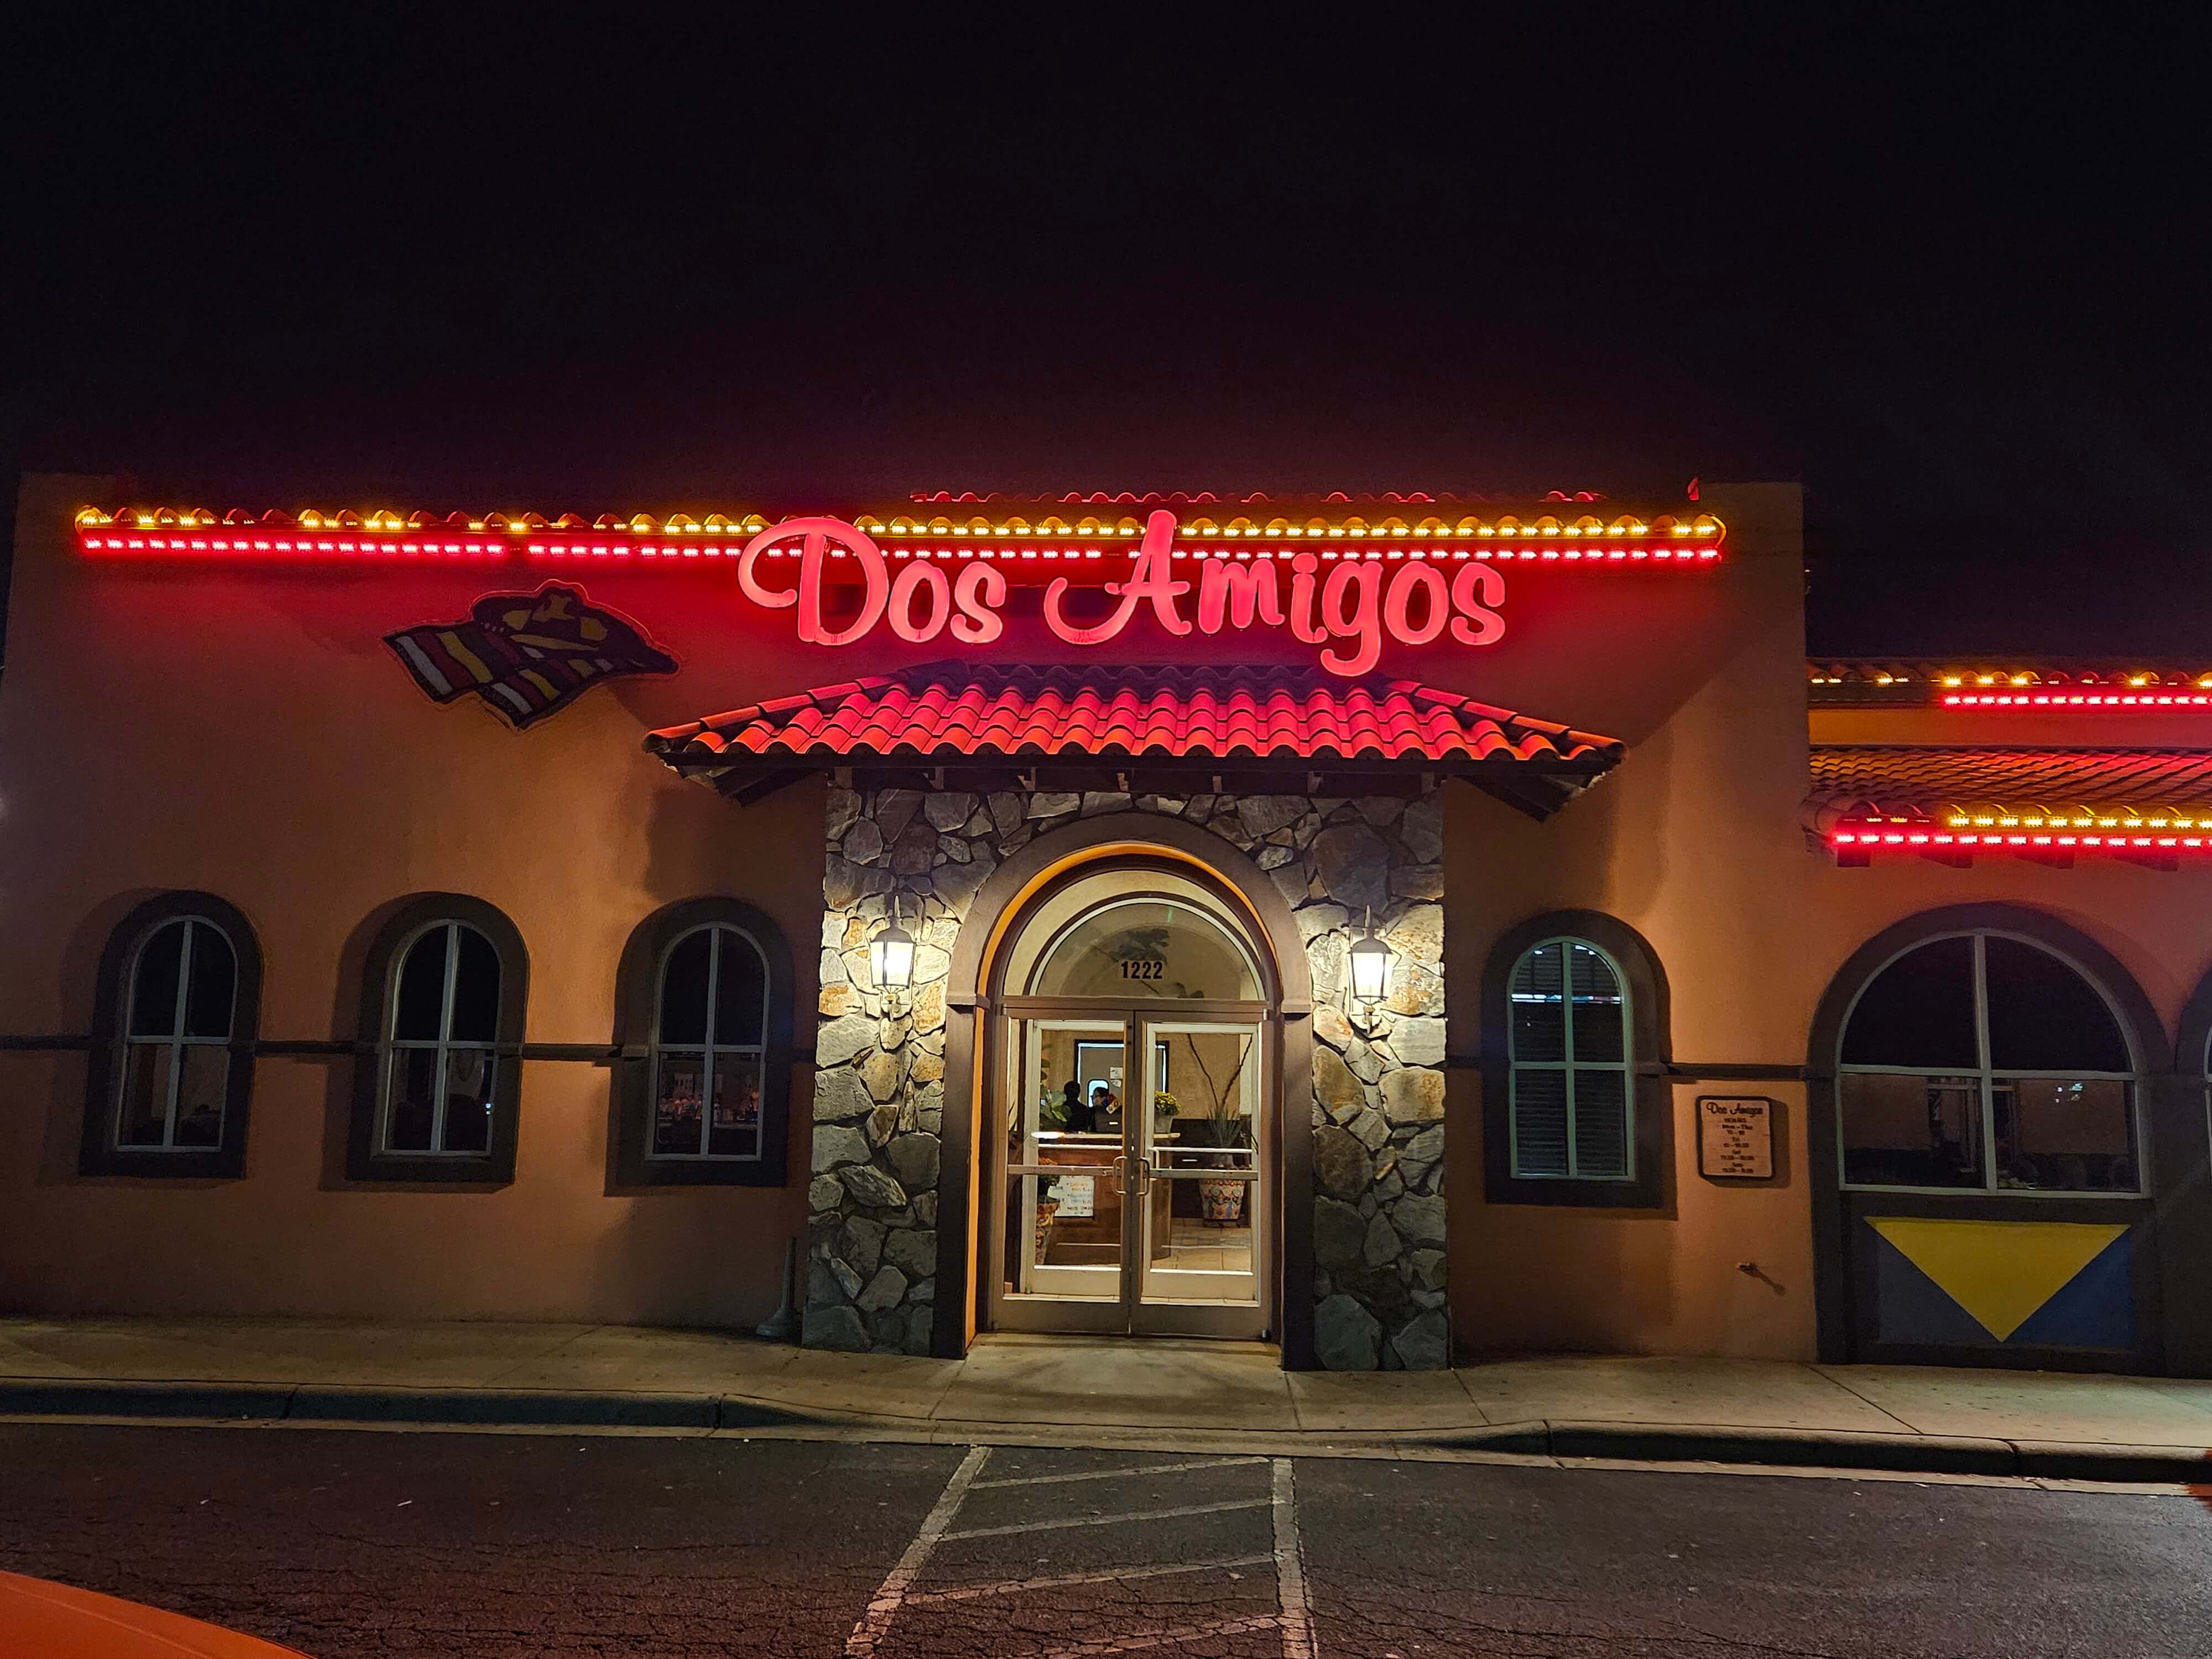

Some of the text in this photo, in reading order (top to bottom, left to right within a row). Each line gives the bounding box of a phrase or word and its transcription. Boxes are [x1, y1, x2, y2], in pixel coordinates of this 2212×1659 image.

[738, 509, 1506, 676] Dos Amigos
[1120, 961, 1162, 979] 1222
